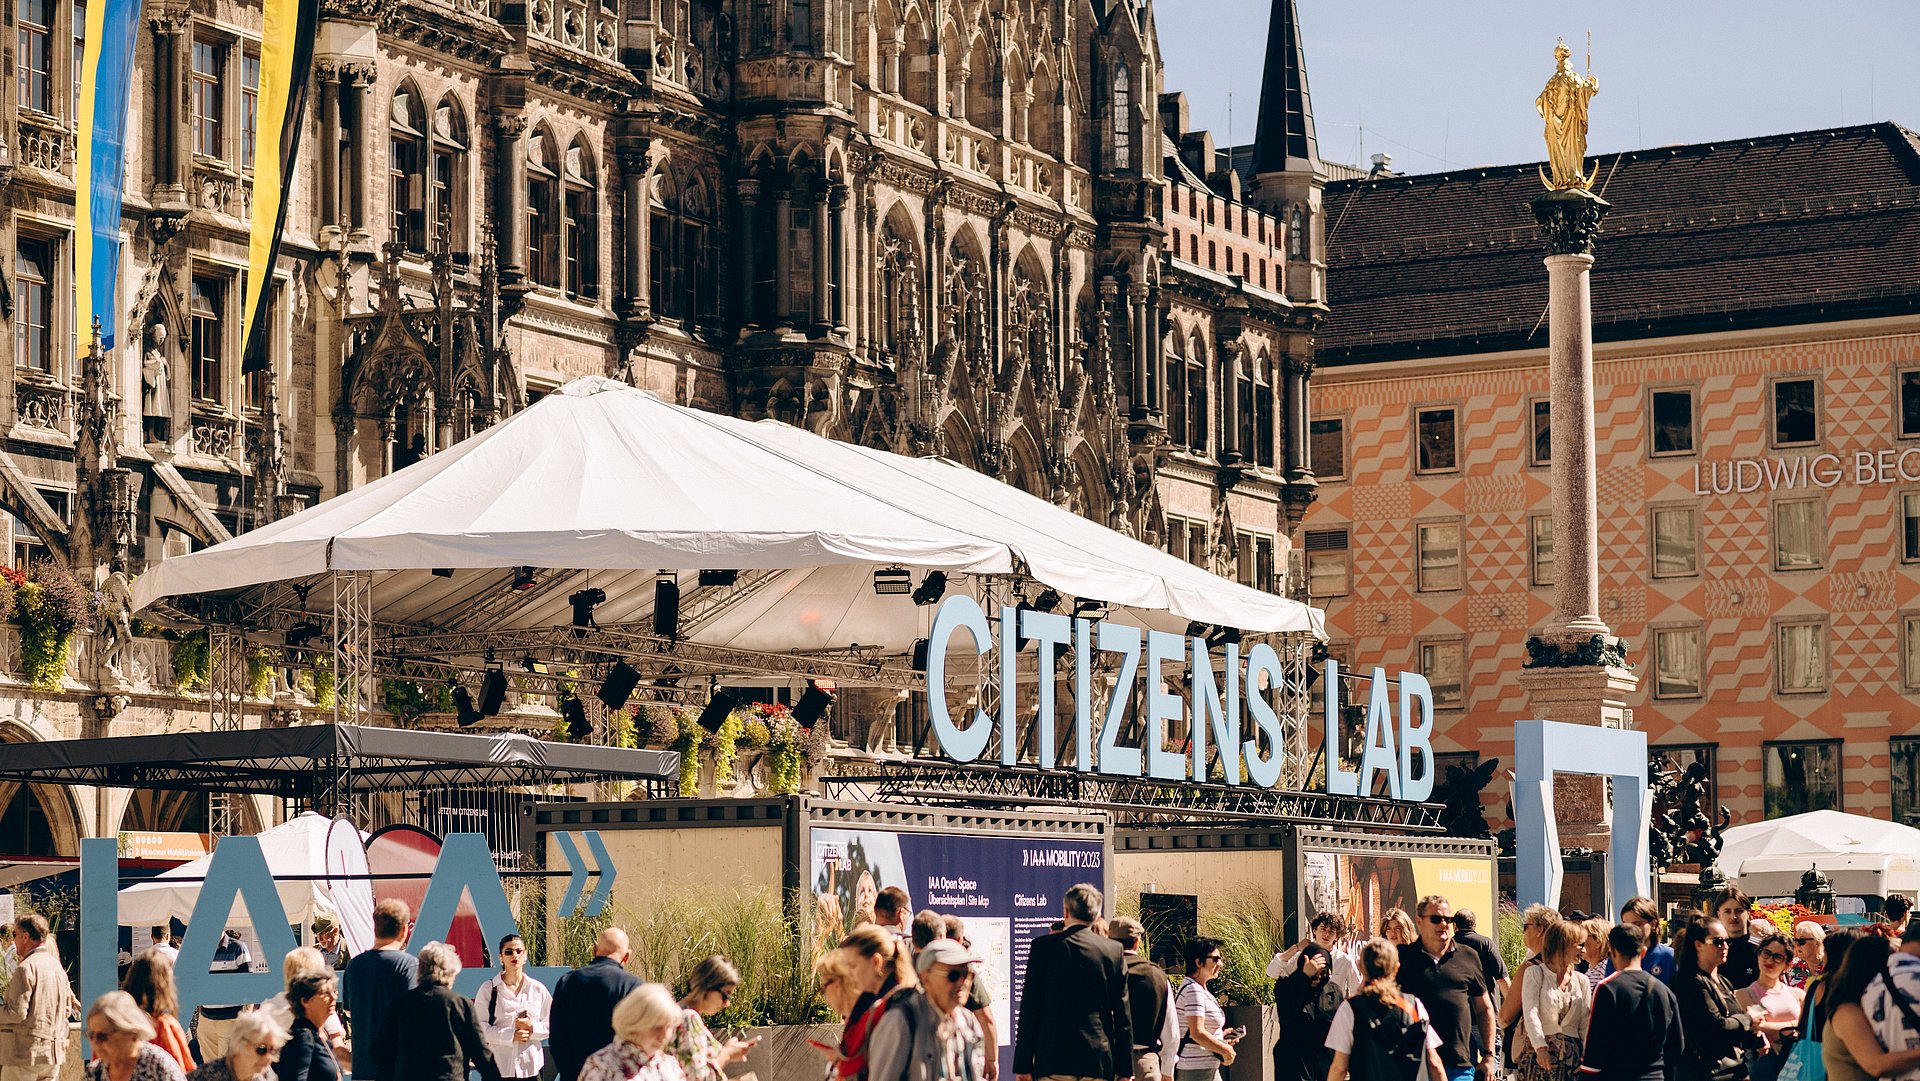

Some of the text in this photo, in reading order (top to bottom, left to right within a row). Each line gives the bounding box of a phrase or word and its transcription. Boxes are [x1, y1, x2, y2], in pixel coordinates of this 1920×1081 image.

[1694, 453, 1843, 495] LUDWIG
[926, 594, 1435, 802] CITIZENS LAB
[438, 807, 451, 815] JETZT
[458, 808, 479, 816] CITIZENS
[479, 808, 488, 817] LAB
[817, 846, 852, 871] CITIZENS LAB
[1030, 850, 1101, 868] IAA MOBILITY 2023
[928, 876, 977, 893] IAA Open Space
[928, 891, 966, 908] Übersichtsplan
[967, 893, 978, 907] Site
[977, 894, 989, 908] Map
[1014, 893, 1047, 907] Citizens Lab
